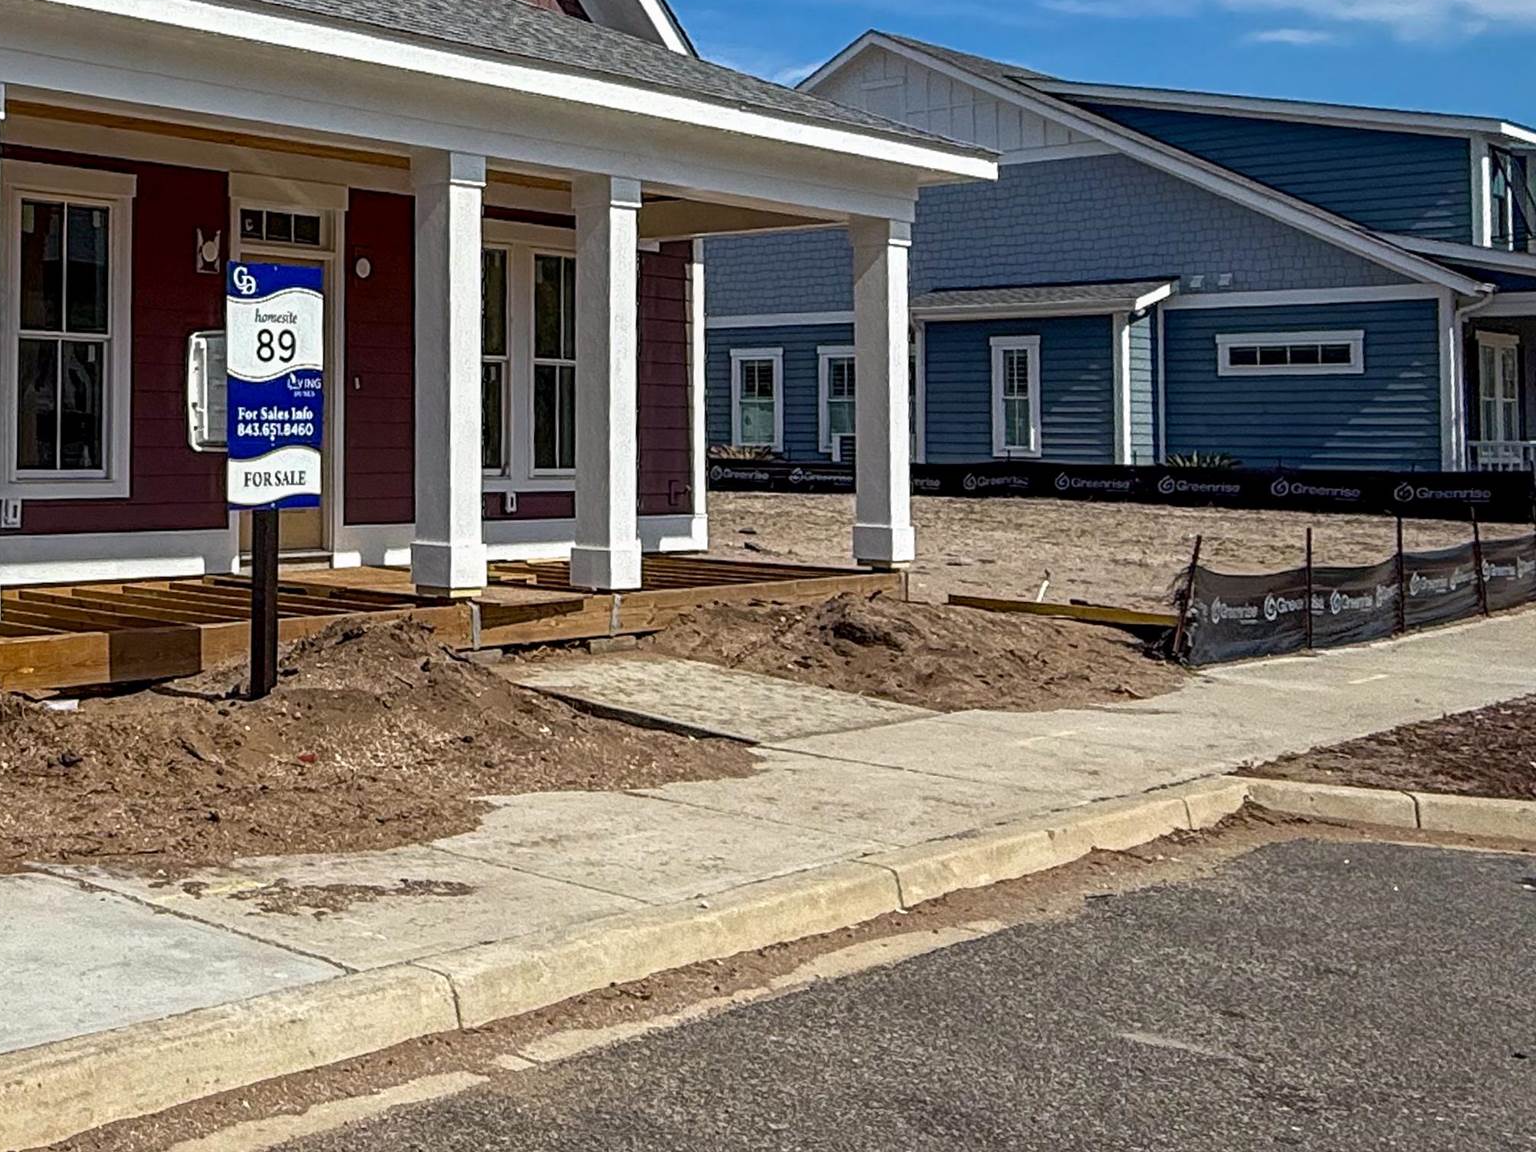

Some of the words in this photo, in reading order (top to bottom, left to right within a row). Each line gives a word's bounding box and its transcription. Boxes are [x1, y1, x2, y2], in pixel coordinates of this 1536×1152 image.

[255, 308, 298, 325] homesite
[256, 328, 296, 363] 89
[237, 407, 258, 421] For
[260, 406, 289, 421] Sales
[291, 406, 314, 421] Info
[244, 471, 272, 487] FOR
[275, 470, 307, 486] SALE
